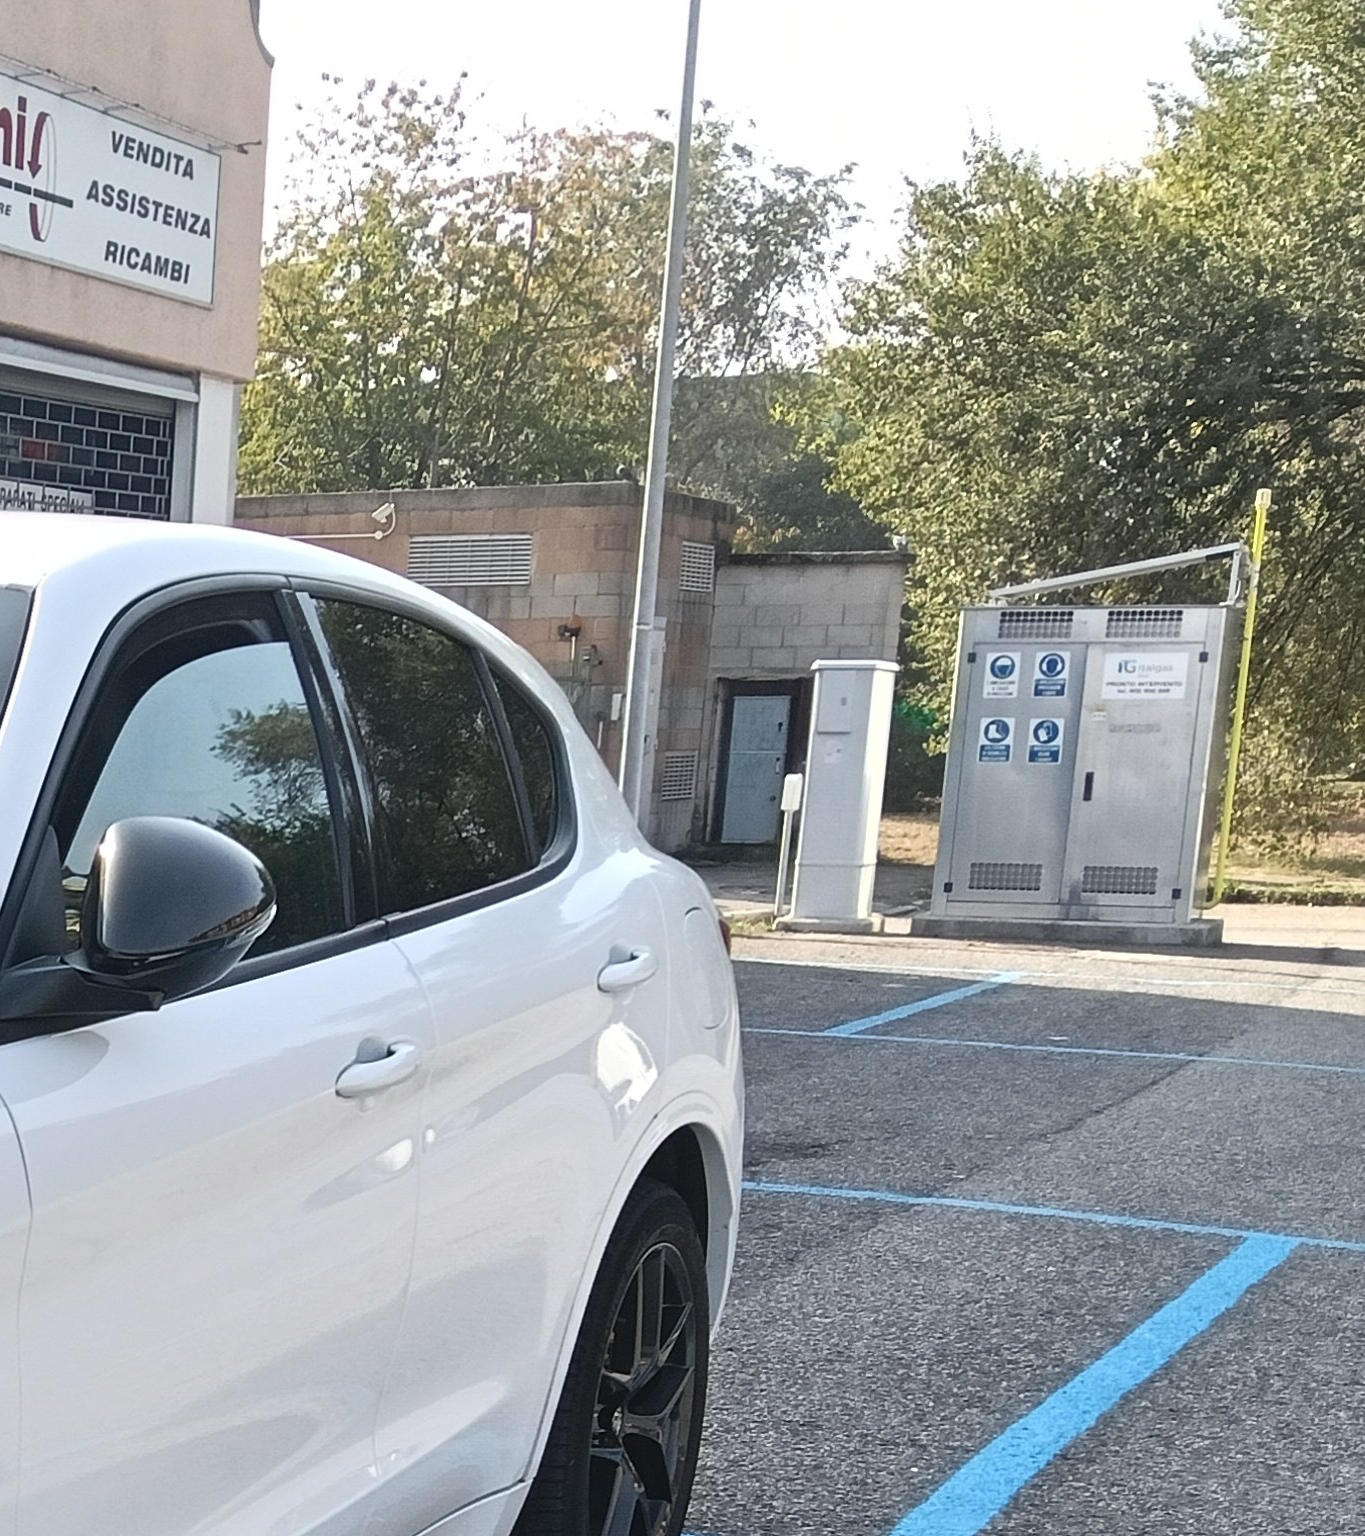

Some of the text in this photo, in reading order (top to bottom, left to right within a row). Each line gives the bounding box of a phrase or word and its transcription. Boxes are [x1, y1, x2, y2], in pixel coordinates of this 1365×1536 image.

[111, 131, 195, 180] VENDITA
[86, 180, 211, 239] ASSISTENZA
[104, 240, 190, 284] RICAMBI
